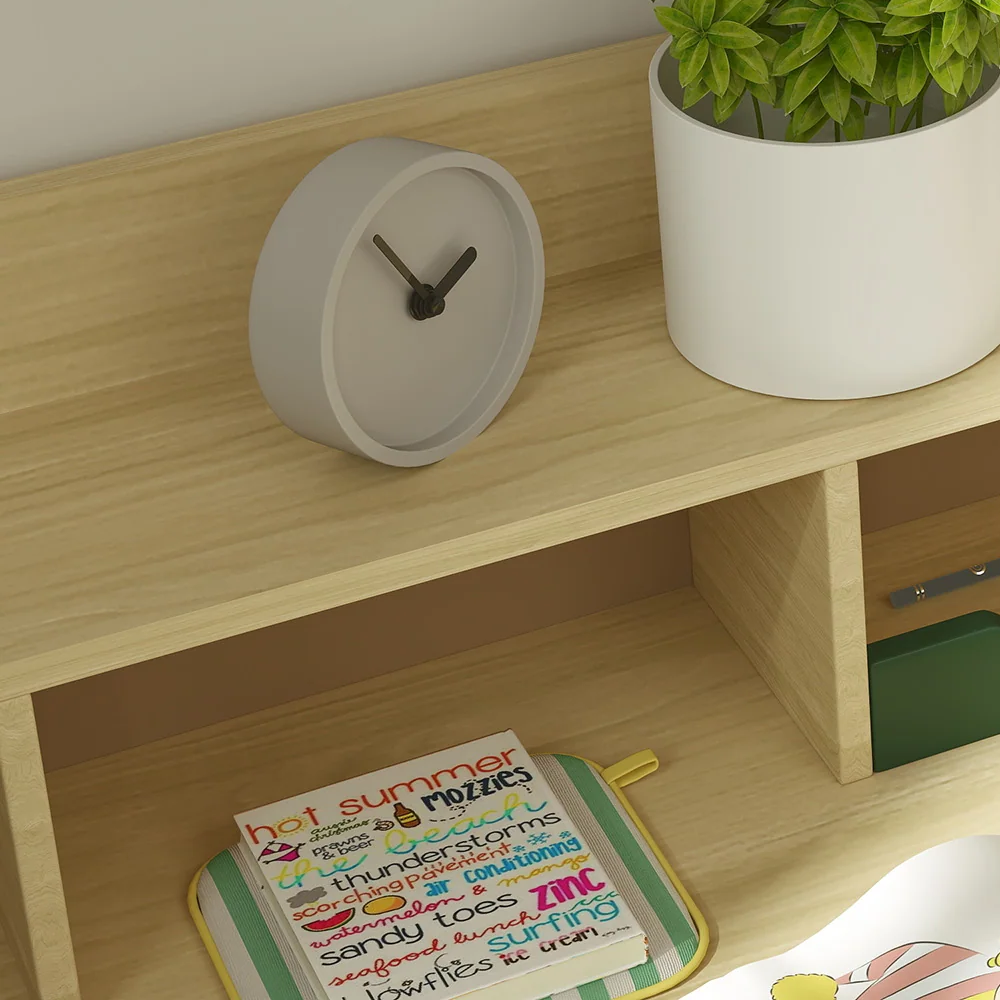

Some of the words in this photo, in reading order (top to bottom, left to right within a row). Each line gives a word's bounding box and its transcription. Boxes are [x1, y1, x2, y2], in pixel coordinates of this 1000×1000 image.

[245, 806, 320, 845] hot
[339, 748, 517, 816] summer
[420, 766, 533, 811] mozzies
[270, 854, 368, 890] the
[384, 793, 547, 855] beach
[309, 819, 370, 843] christmas
[311, 817, 357, 834] aussie
[312, 832, 370, 857] prawns
[322, 851, 336, 860] &
[338, 839, 375, 855] beer
[331, 812, 562, 892] thunderstorms
[292, 879, 404, 921] scorching
[404, 842, 513, 889] pavement
[423, 878, 451, 897] air
[463, 835, 582, 884] conditioning
[310, 894, 466, 949] watermelon
[472, 884, 487, 896] &
[497, 853, 591, 887] mango
[320, 923, 424, 967] sandy
[433, 893, 519, 928] toes
[487, 900, 620, 952] surfing
[327, 938, 447, 987] seafood
[453, 911, 541, 945] lunch
[499, 948, 531, 966] ice
[538, 927, 599, 953] cream
